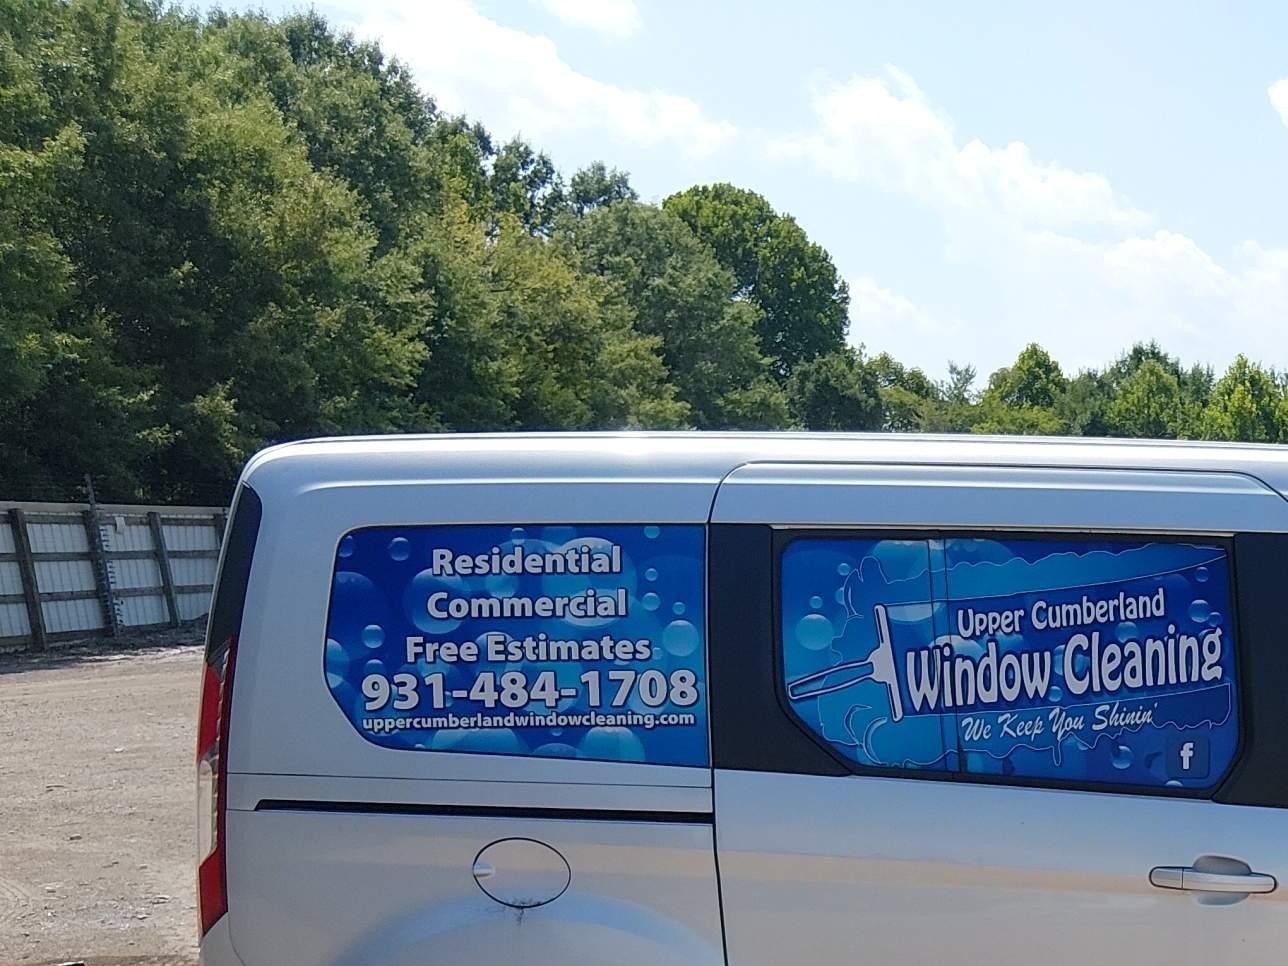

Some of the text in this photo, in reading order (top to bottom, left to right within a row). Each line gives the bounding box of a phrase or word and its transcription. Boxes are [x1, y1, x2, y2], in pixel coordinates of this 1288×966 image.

[432, 545, 621, 575] Residential
[427, 589, 627, 618] Commercial
[958, 587, 1165, 638] Upper Cumberland
[406, 634, 651, 663] Free Estimates
[906, 624, 1222, 711] Window Cleaning
[361, 669, 699, 711] 931-484-1708
[362, 712, 695, 730] uppercumberlandwindowcleaning.com
[961, 701, 1158, 743] We Keep You Shinin'
